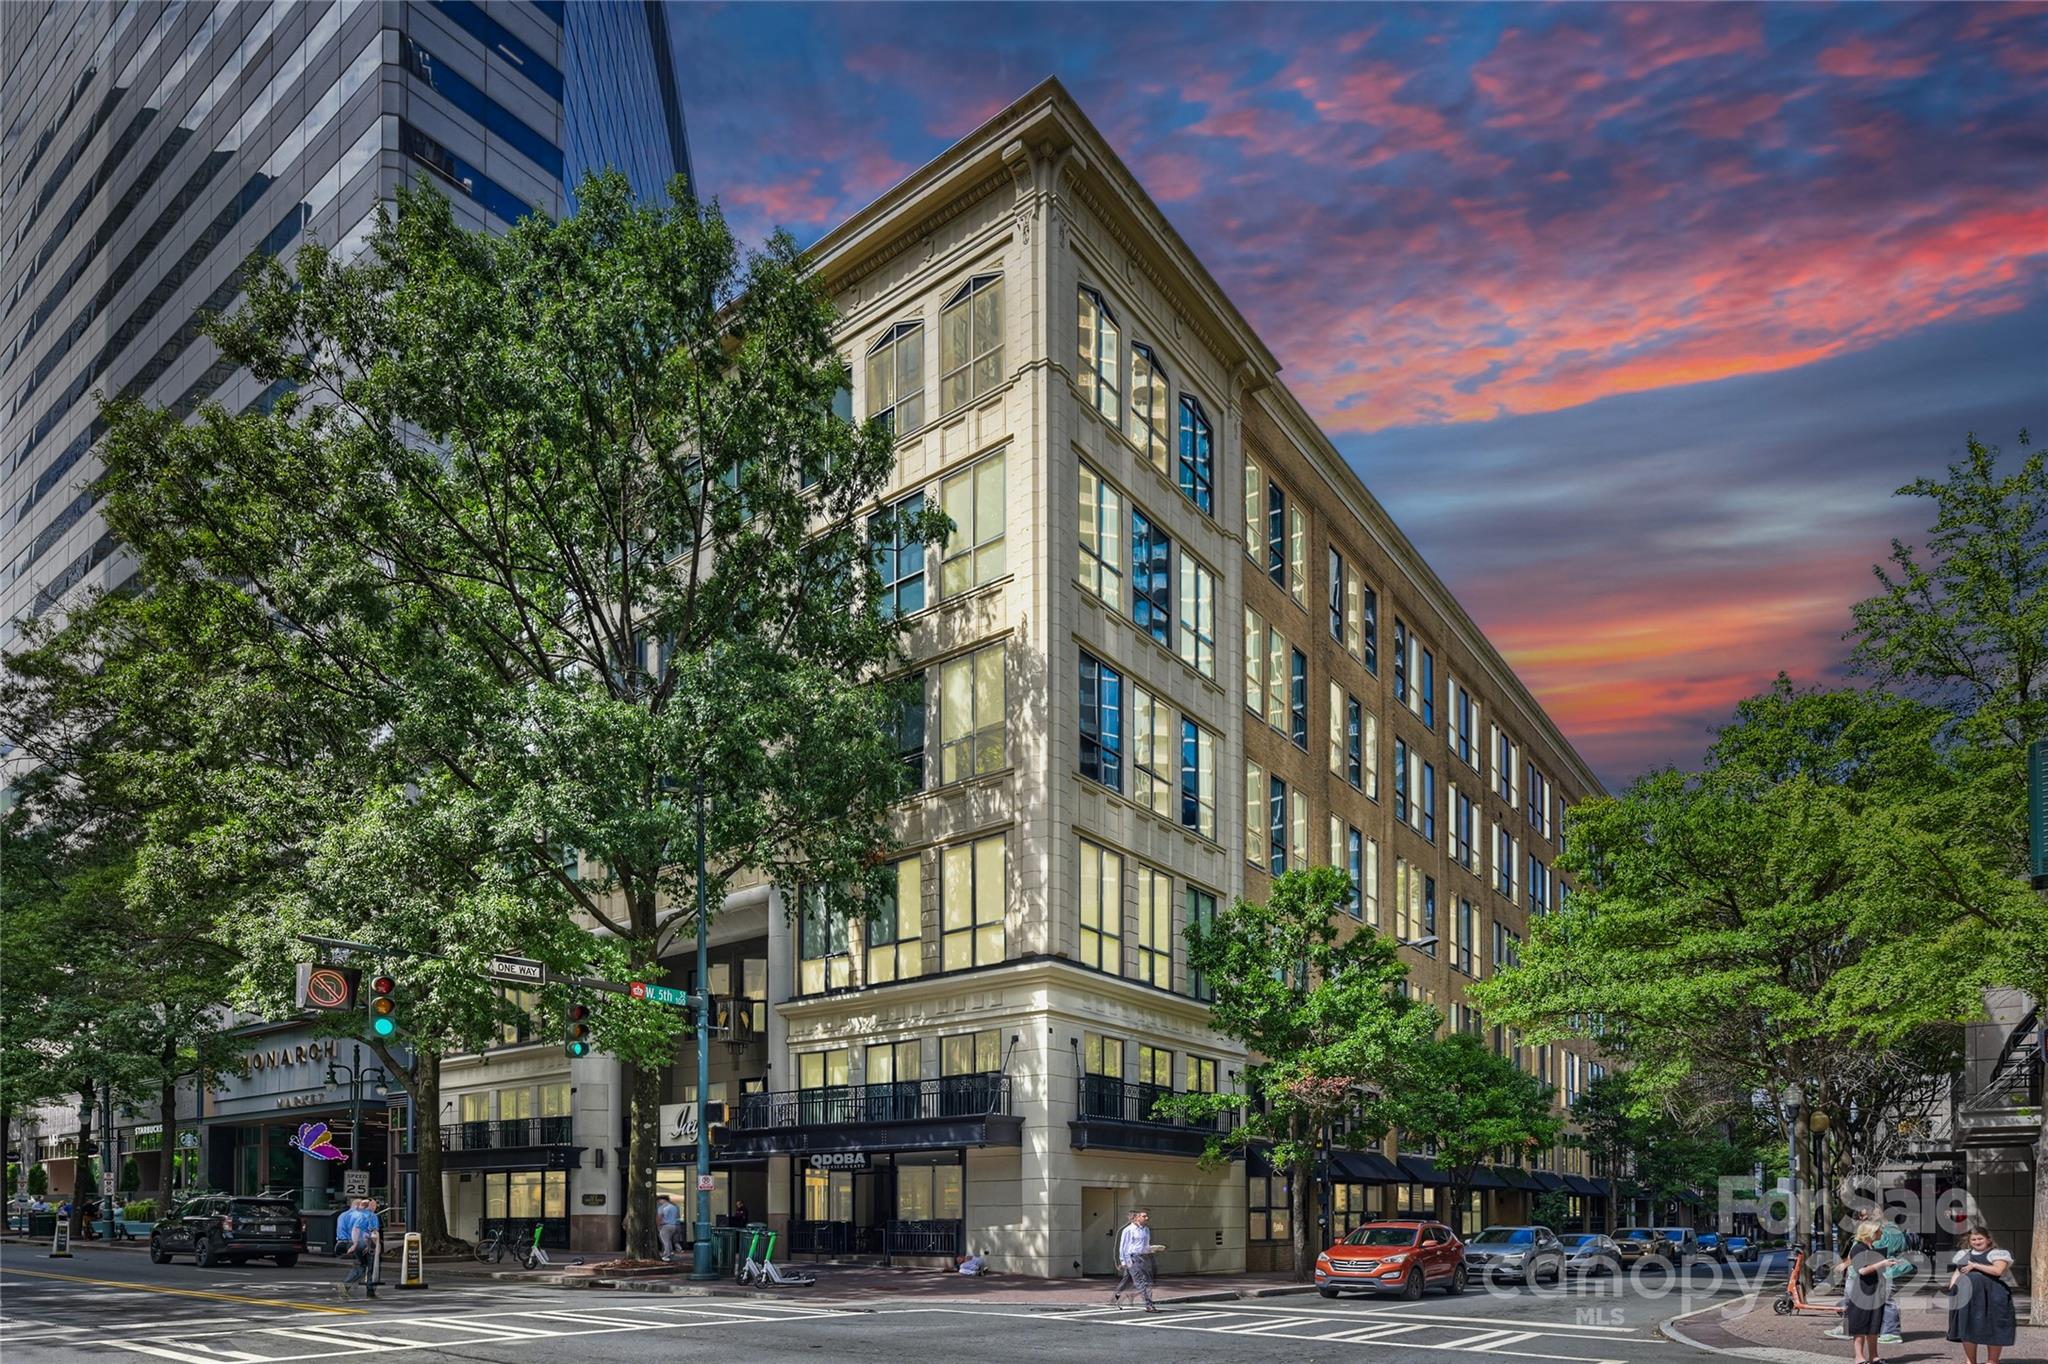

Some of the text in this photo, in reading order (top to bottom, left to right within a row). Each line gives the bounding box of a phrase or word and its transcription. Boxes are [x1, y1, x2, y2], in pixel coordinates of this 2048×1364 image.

[497, 963, 537, 976] ONE WAY
[658, 989, 673, 1002] 5th
[135, 1124, 163, 1135] STARBUCKS
[810, 1152, 866, 1169] QDOBA
[346, 1184, 366, 1194] 25
